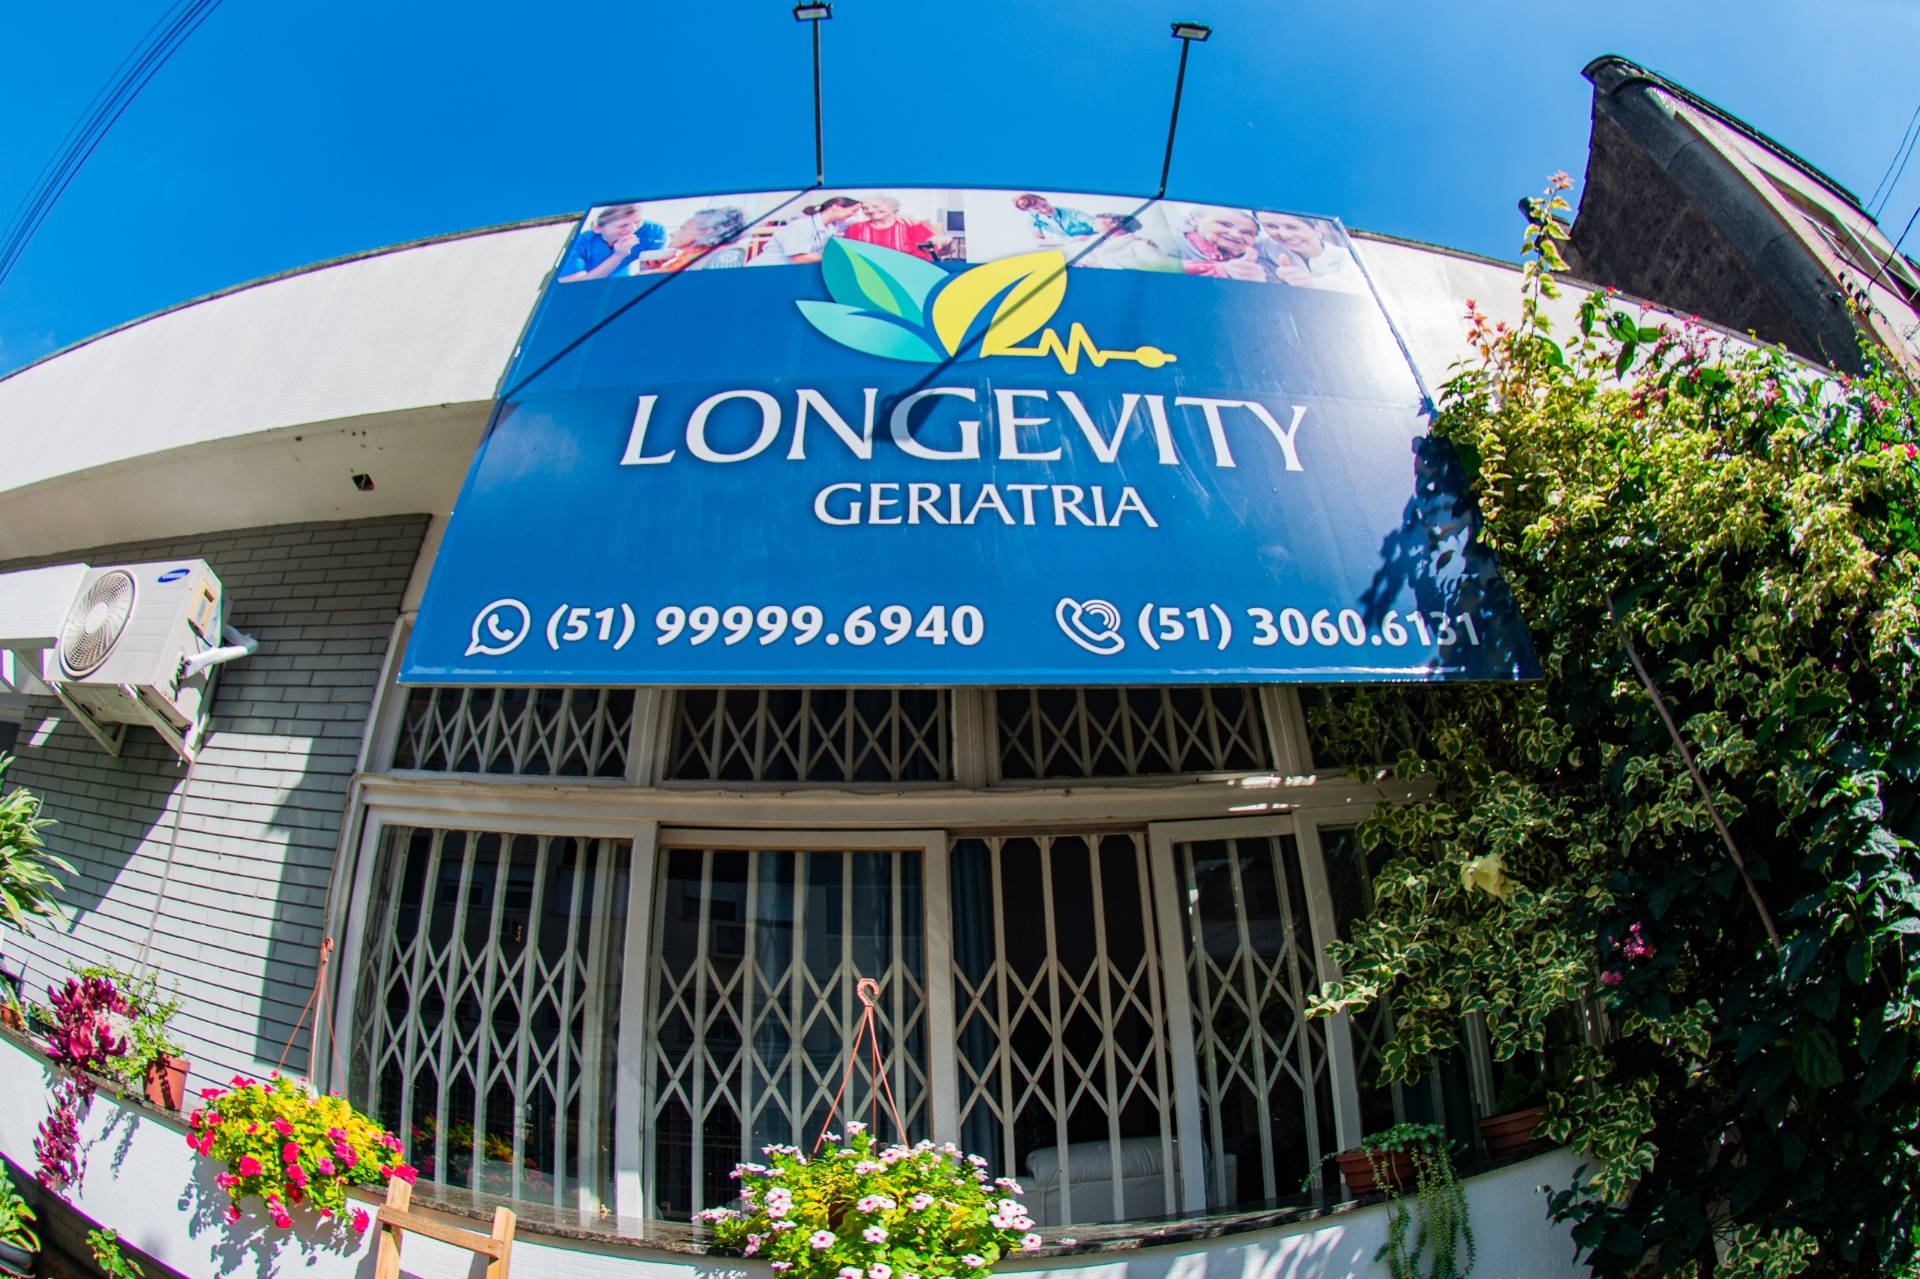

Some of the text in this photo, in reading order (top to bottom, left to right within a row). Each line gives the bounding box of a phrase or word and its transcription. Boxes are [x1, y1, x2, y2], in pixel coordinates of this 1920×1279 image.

[620, 387, 1308, 472] LONGEVITY
[813, 482, 1159, 528] GERIATRIA
[546, 602, 984, 651] (51) 99999.6940
[1138, 602, 1481, 651] (51) 3060.6131
